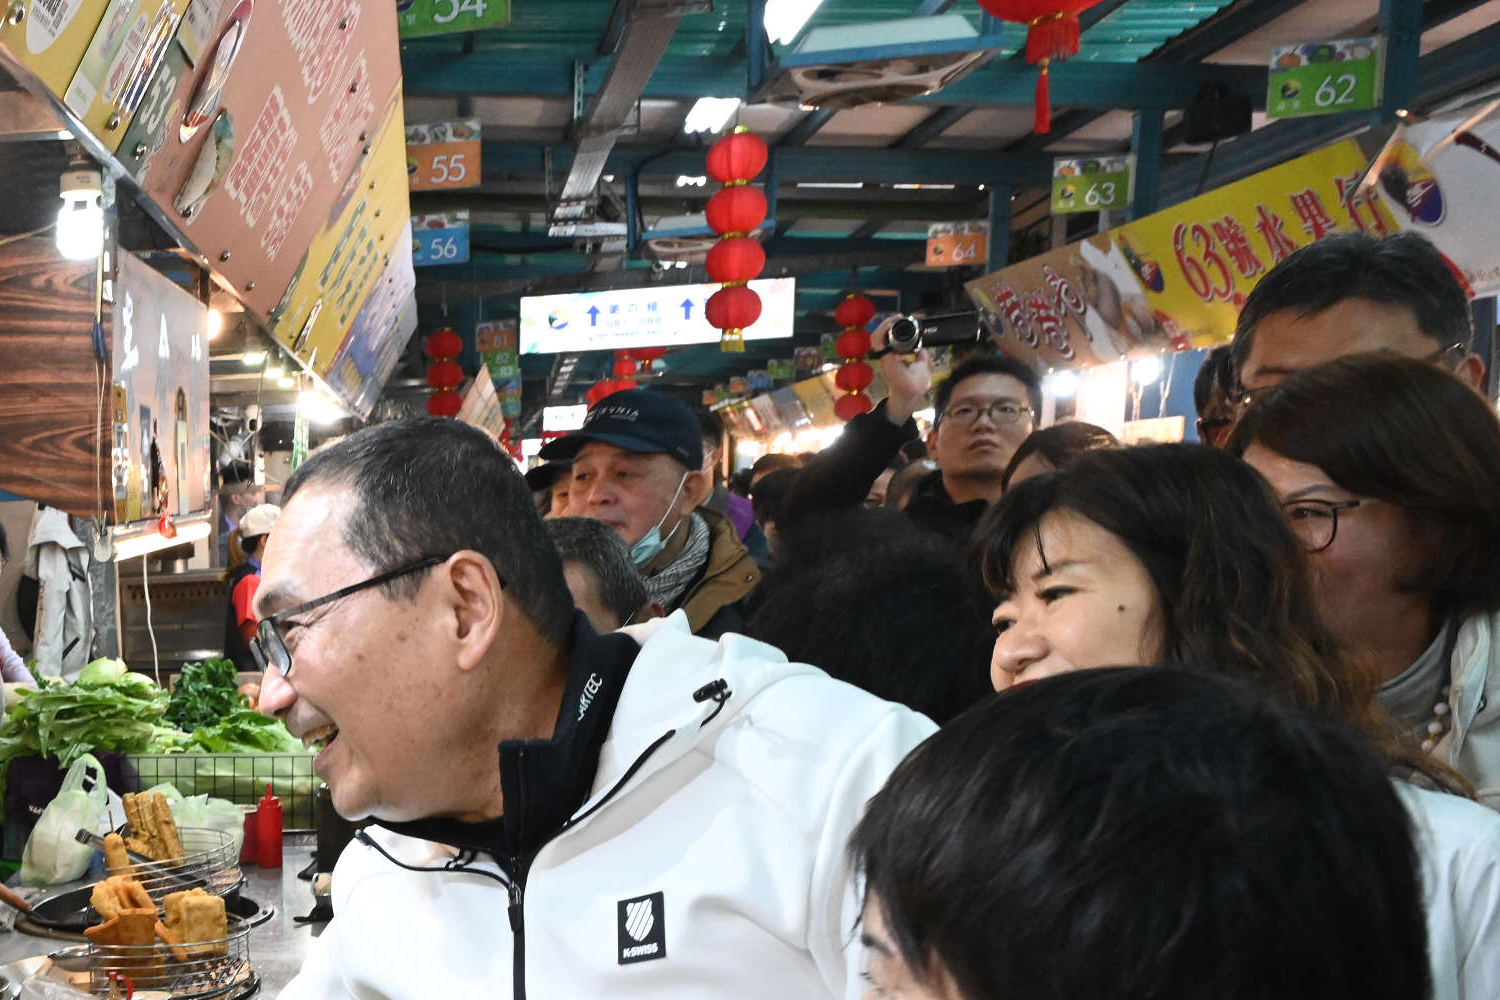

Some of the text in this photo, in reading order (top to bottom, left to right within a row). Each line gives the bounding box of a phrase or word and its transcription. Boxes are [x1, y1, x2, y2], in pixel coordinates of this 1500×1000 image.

[433, 0, 487, 22] 54
[1314, 73, 1357, 107] 62
[431, 154, 467, 185] 55
[1084, 181, 1117, 207] 63
[429, 237, 459, 260] 56
[950, 240, 977, 262] 64
[622, 942, 659, 959] K-SWISS
